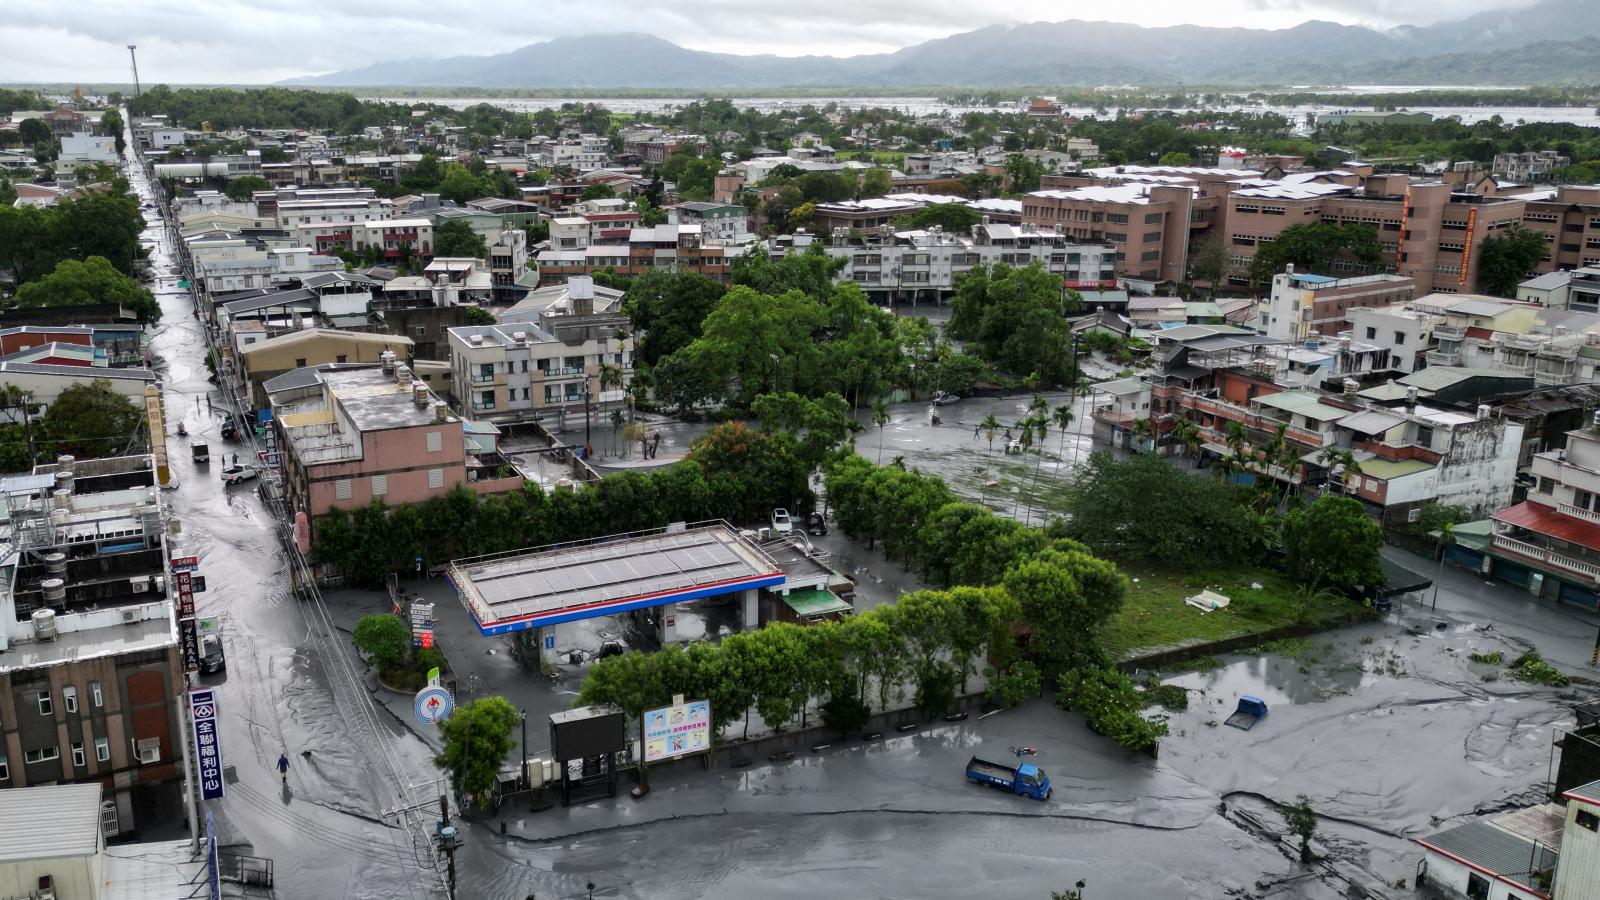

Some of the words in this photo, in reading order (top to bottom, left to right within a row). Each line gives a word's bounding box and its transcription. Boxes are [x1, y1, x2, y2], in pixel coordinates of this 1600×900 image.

[198, 721, 219, 791] 全聯福利中心
